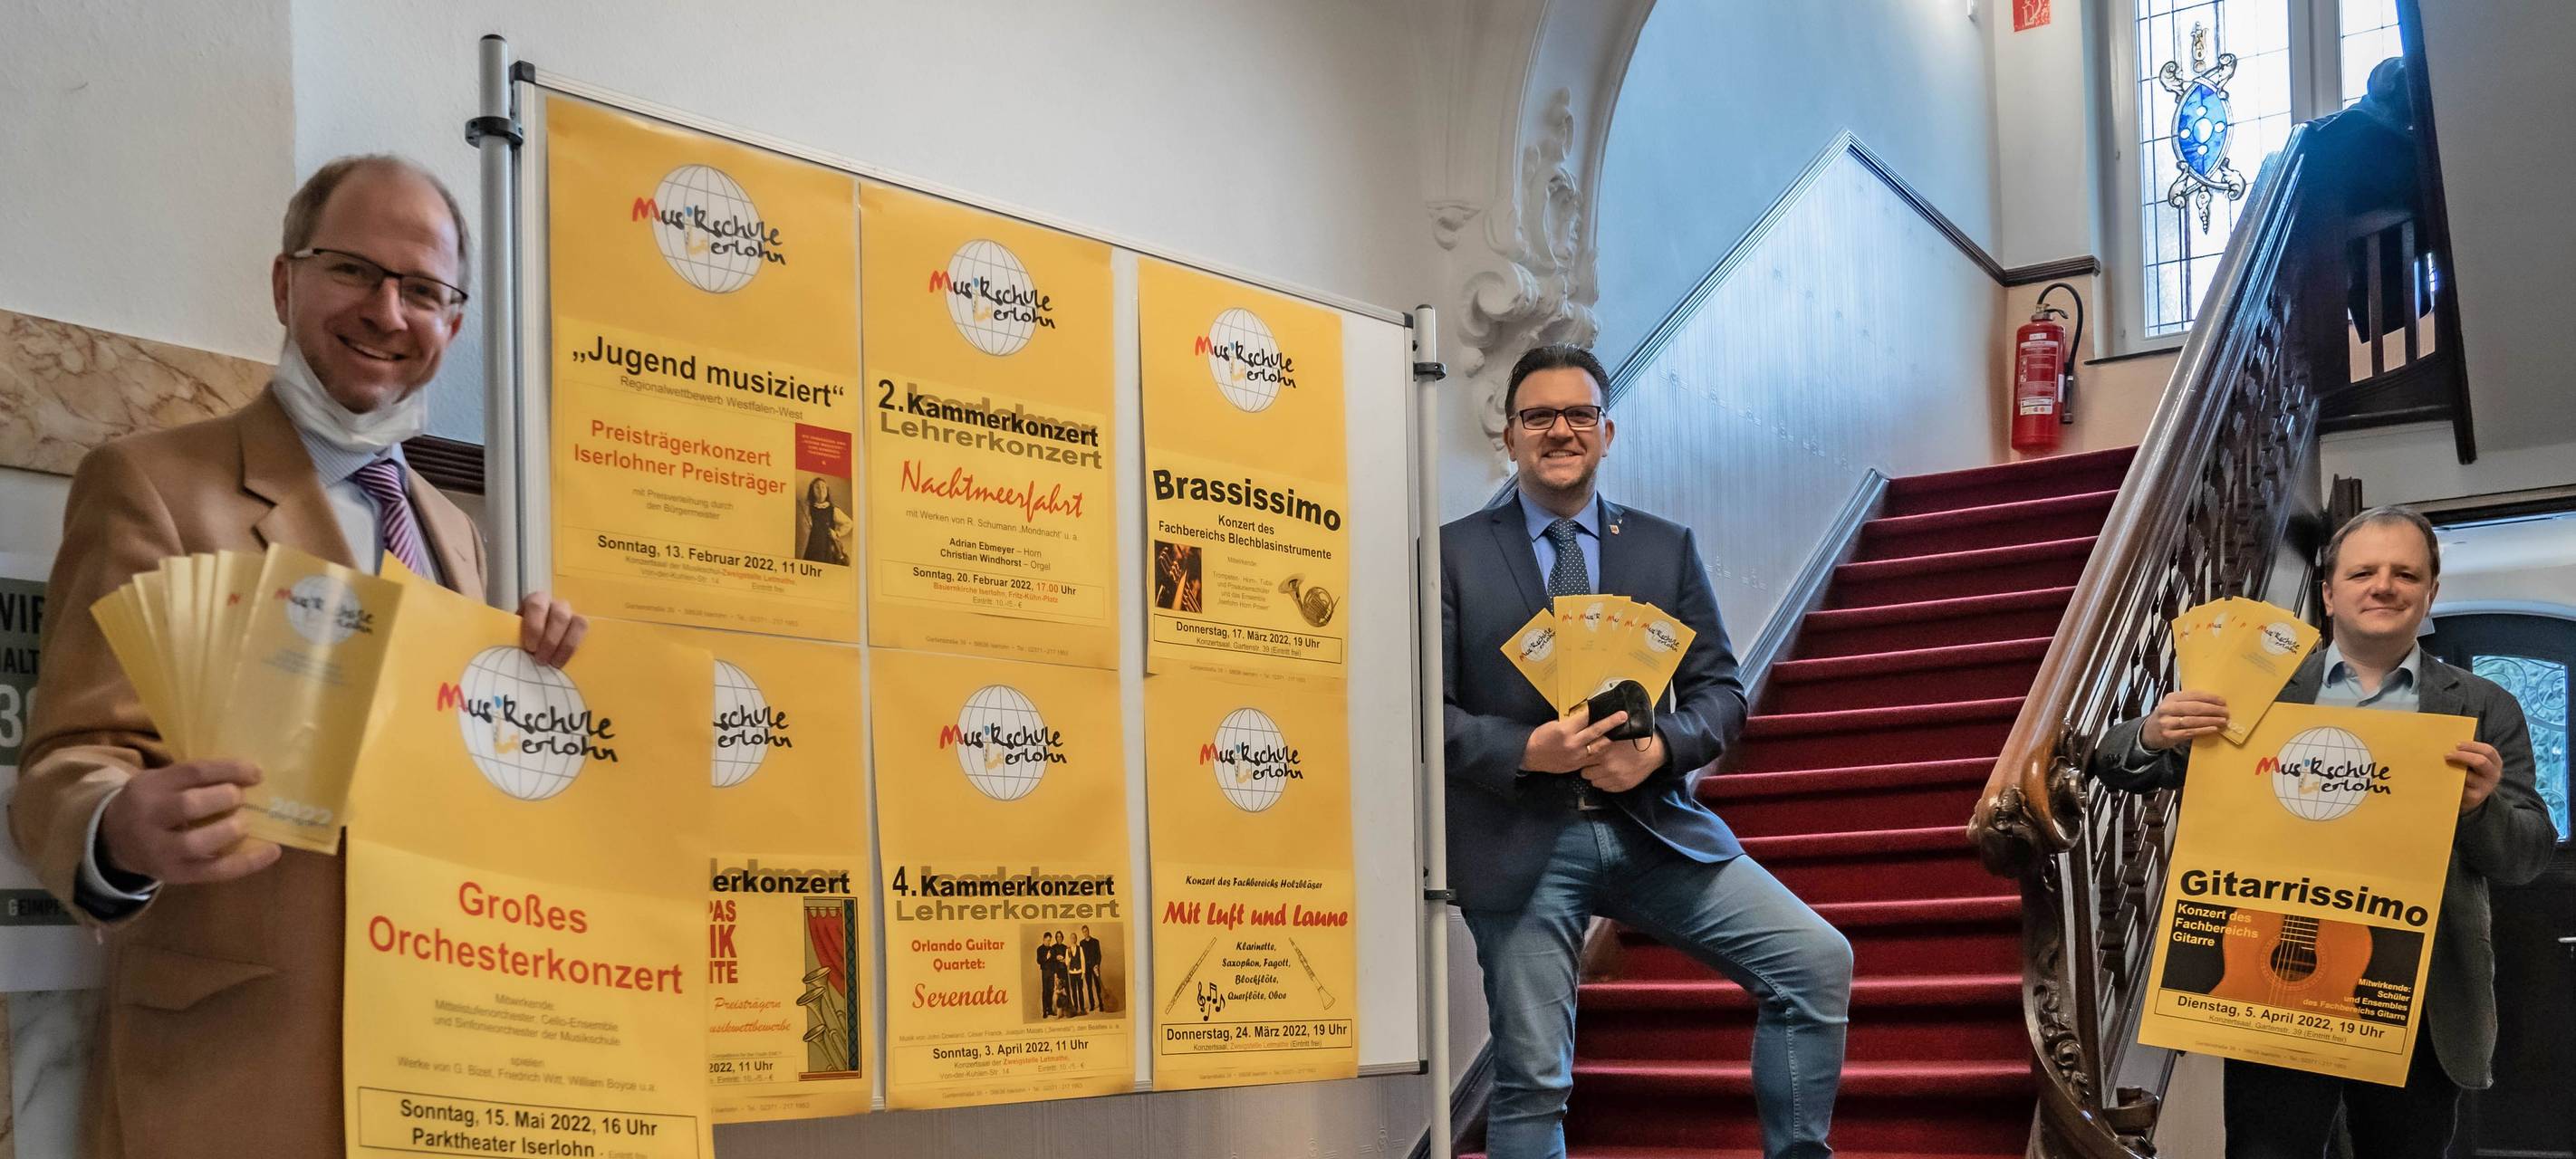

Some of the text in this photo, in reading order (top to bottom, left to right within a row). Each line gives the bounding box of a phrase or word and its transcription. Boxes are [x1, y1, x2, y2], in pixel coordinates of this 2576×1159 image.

[572, 336, 844, 407] „Jugend musiziert“
[620, 376, 803, 420] Regionalwettbewerb Westfalen-West
[908, 392, 1099, 447] Kammerkonzert
[591, 420, 772, 467] Preisträgerkonzert
[880, 412, 1101, 470] Lehrerkonzert
[574, 444, 786, 495] Iserlohner Preisträger
[901, 460, 1083, 522] Nachtmeerfahrt
[1153, 469, 1341, 532] Brassissimo
[906, 510, 918, 519] mit
[919, 511, 949, 523] Werken
[951, 516, 966, 524] von
[977, 519, 1016, 532] Schumann
[1218, 514, 1274, 535] Konzert des
[949, 538, 1042, 558] Adrian Ebmeyer Horn
[1158, 520, 1332, 560] Fachbereichs Blechblasinstrumente
[598, 535, 660, 558] Sonntag,
[666, 546, 684, 559] 13.
[689, 548, 740, 566] Februar
[745, 555, 777, 573] 2022,
[783, 561, 795, 574] 11
[801, 564, 822, 578] Uhr
[940, 548, 1051, 571] Christian Windhorst Orgel
[913, 567, 1076, 596] Sonntag, 20. Februar 2022, 17.00 Uhr
[1176, 621, 1320, 650] Donnerstag, 17. März 2022, 19 Uhr
[921, 875, 1115, 897] Kammerkonzert
[1186, 876, 1322, 890] Konzert des Fachbereichs Holzbläser
[458, 881, 588, 934] Großes
[2180, 869, 2429, 928] Gitarrissimo
[710, 900, 736, 923] AS
[896, 899, 1120, 922] Lehrerkonzert
[1163, 901, 1348, 931] Mit Luft und Laune
[2177, 904, 2252, 924] Konzert des
[2172, 931, 2216, 947] Gitarre
[2175, 917, 2259, 939] Fachbereichs
[369, 915, 683, 994] Orchesterkonzert
[911, 938, 1005, 953] Orlando Guitar
[1236, 942, 1276, 952] Klarinette,
[933, 958, 985, 972] Quartet:
[1222, 958, 1291, 969] Saxophon, Fagott,
[1235, 974, 1279, 985] Blockflöte,
[2359, 978, 2411, 992] Mitwirkende:
[912, 982, 1009, 1010] Serenata
[1227, 991, 1286, 1002] Querflöte, Oboe
[2343, 996, 2408, 1011] und Ensembles
[2378, 991, 2410, 1001] Schüler
[2177, 995, 2385, 1039] Dienstag, 5. April 2022, 19 Uhr
[2302, 999, 2406, 1020] des Fachbereichs Gitarre
[1167, 1023, 1347, 1041] Donnerstag, 24. März 2022, 19 Uhr
[2292, 1028, 2302, 1036] 39
[932, 1039, 1089, 1059] Sonntag, 3. April 2022, 11 Uhr
[739, 1061, 750, 1071] 11
[755, 1060, 774, 1071] Uhr
[400, 1099, 658, 1136] Sonntag, 15. Mai 2022, 16 Uhr
[412, 1127, 594, 1158] Parktheater Iserlohn
